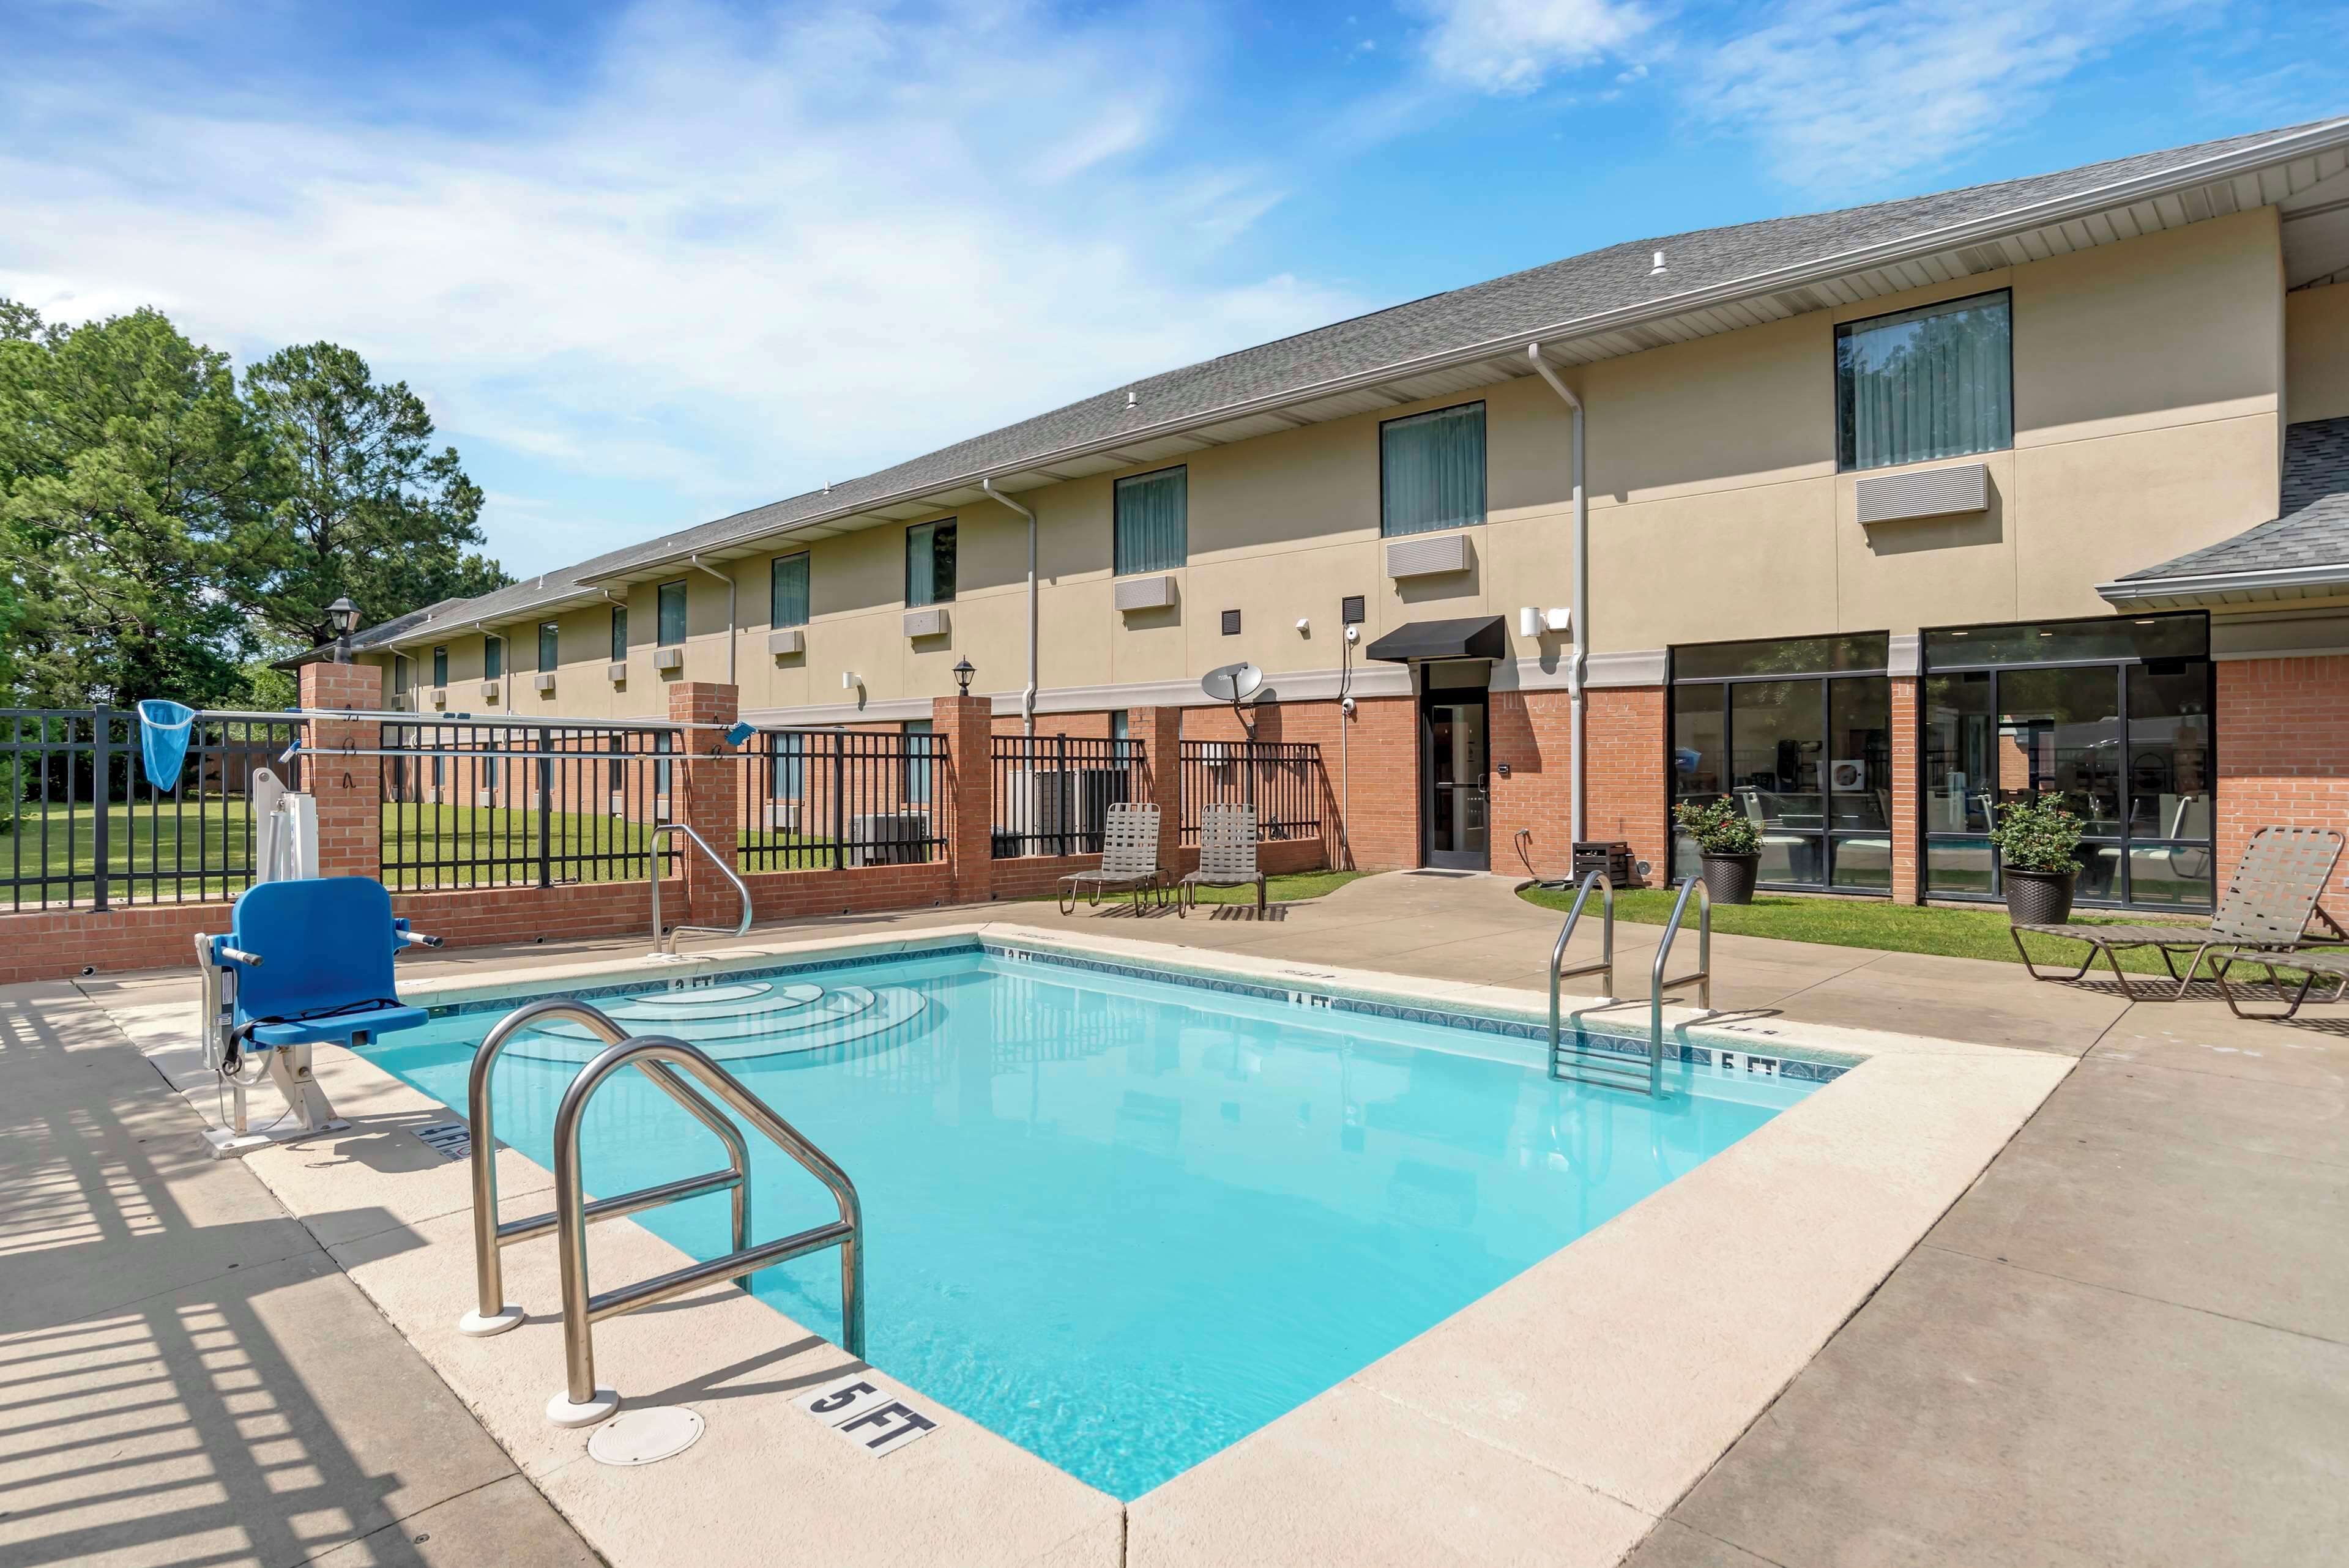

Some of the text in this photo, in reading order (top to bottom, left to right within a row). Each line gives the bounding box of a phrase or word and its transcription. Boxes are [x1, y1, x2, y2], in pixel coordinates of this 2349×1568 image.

[1722, 1053, 1777, 1076] 5 FT
[810, 1381, 937, 1449] 5 FT
